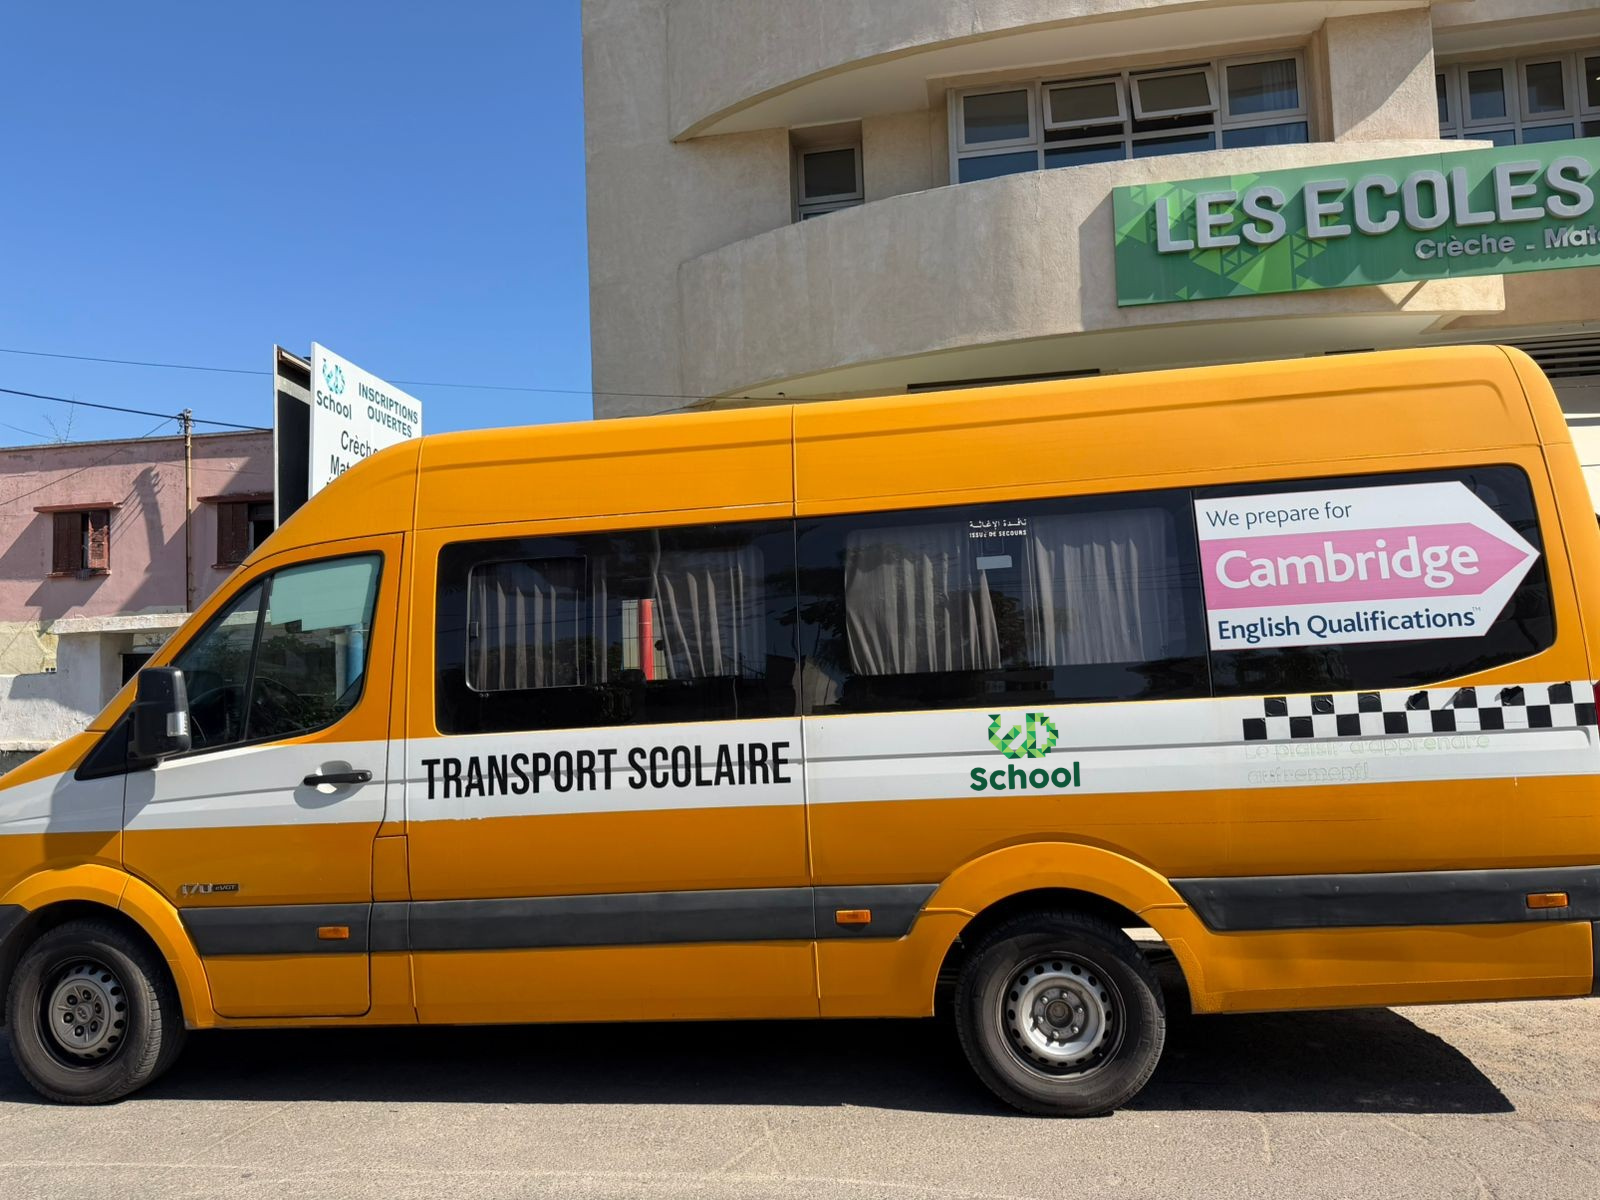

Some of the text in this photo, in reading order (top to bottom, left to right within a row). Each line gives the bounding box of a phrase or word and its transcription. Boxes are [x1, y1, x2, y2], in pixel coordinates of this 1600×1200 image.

[1155, 156, 1594, 255] LES ECOLES
[1415, 233, 1516, 260] Crèche
[316, 390, 352, 420] School
[358, 382, 418, 425] INSCRIPTIONS
[367, 405, 412, 438] OUVERTES
[1206, 501, 1352, 529] We prepare for
[1215, 535, 1480, 589] Cambridge
[1217, 615, 1301, 644] English
[421, 741, 791, 800] TRANSPORT SCOLAIRE
[970, 761, 1081, 791] School
